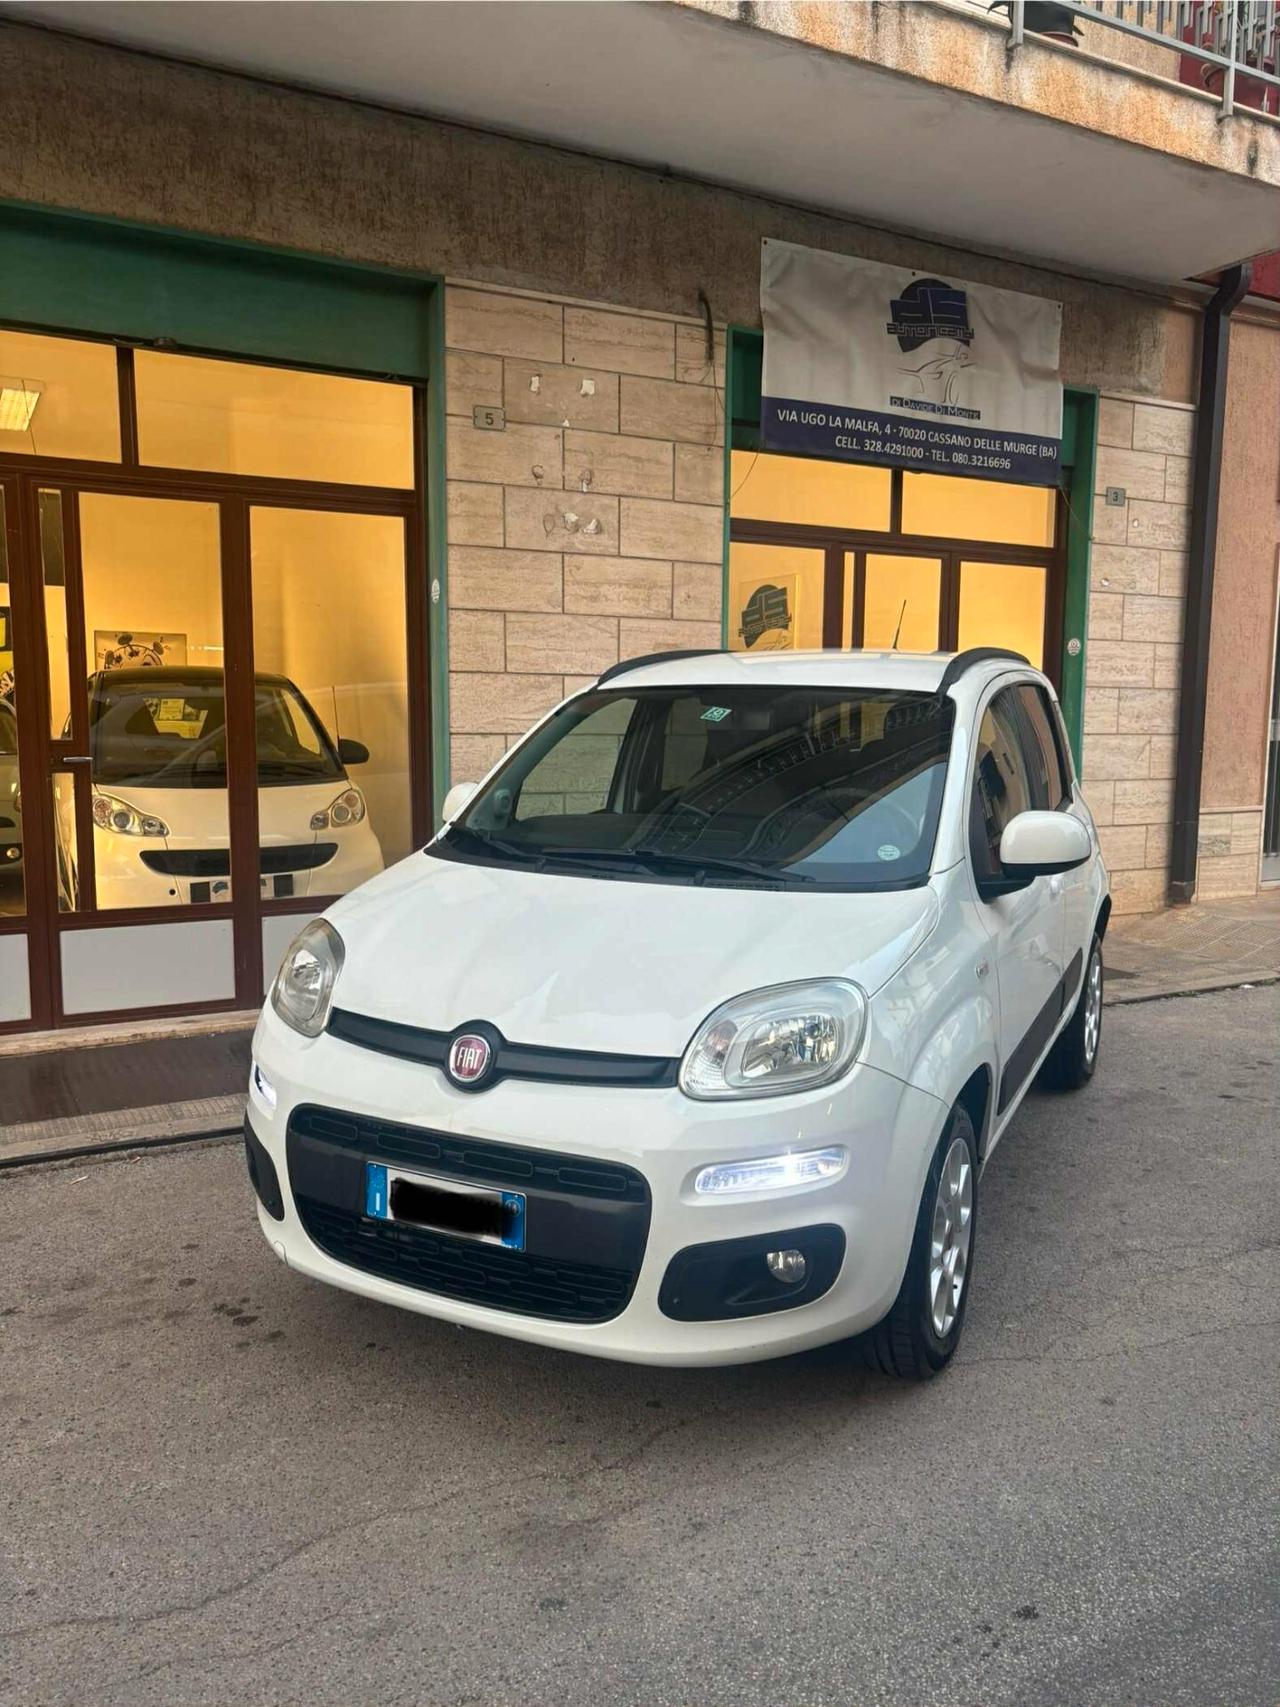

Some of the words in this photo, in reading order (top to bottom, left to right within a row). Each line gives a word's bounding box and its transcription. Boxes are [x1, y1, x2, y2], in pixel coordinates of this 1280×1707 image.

[485, 412, 494, 426] 5
[777, 409, 798, 422] VIA
[800, 412, 826, 426] UGO
[829, 415, 842, 428] LA
[844, 417, 883, 435] MALFA,
[884, 424, 891, 435] 4
[898, 426, 926, 441] 70020
[928, 431, 971, 448] CASSANO
[974, 438, 1000, 451] DELLE
[1003, 441, 1037, 456] MURGE
[1039, 445, 1057, 460] (BA)
[835, 435, 861, 449] CELL.
[864, 439, 924, 459] 328.4291000
[931, 449, 950, 462] TEL.
[952, 452, 1011, 469] 080.3216696
[1112, 491, 1119, 502] 3
[456, 1046, 483, 1070] FIAT
